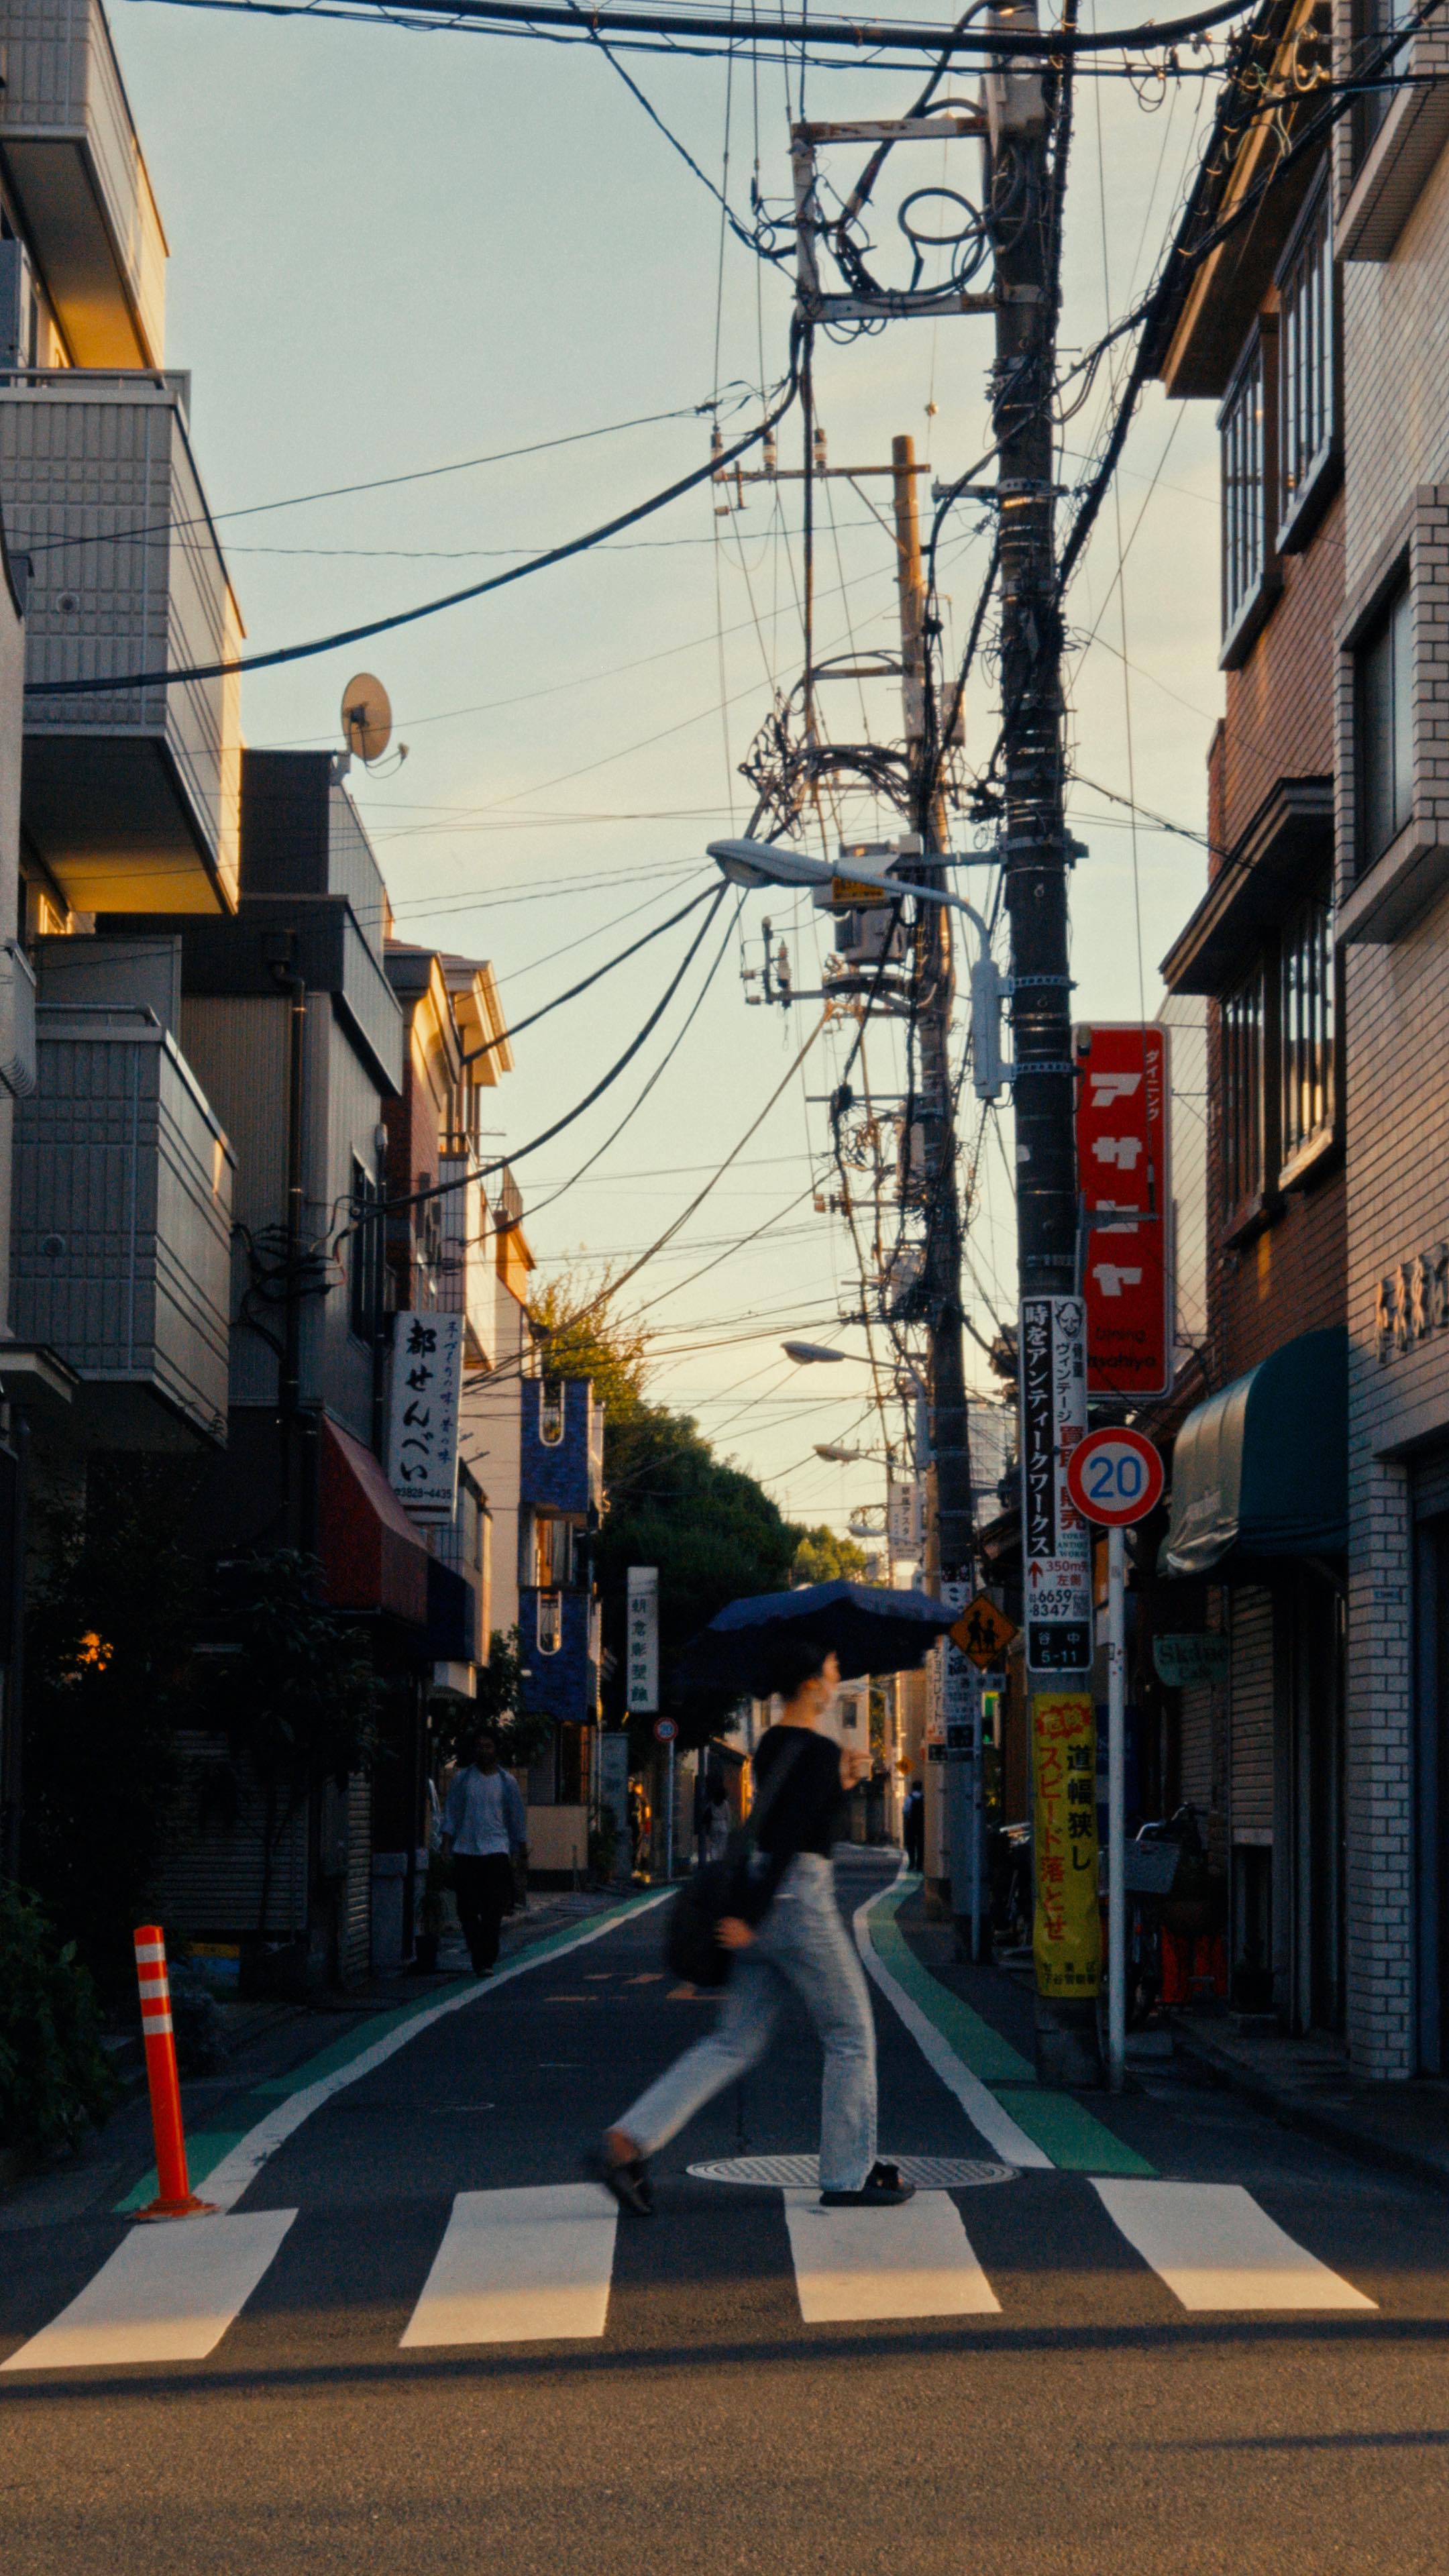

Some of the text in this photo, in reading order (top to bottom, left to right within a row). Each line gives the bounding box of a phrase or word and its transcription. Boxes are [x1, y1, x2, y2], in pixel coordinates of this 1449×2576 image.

[1146, 1049, 1160, 1122] ダイニング
[400, 1318, 437, 1481] 都せんべい
[1024, 1303, 1050, 1555] 時をアンティークワークス
[1089, 1456, 1140, 1497] 20
[1040, 1650, 1078, 1663] 5-11
[1038, 1747, 1067, 1941] スピード落とせ
